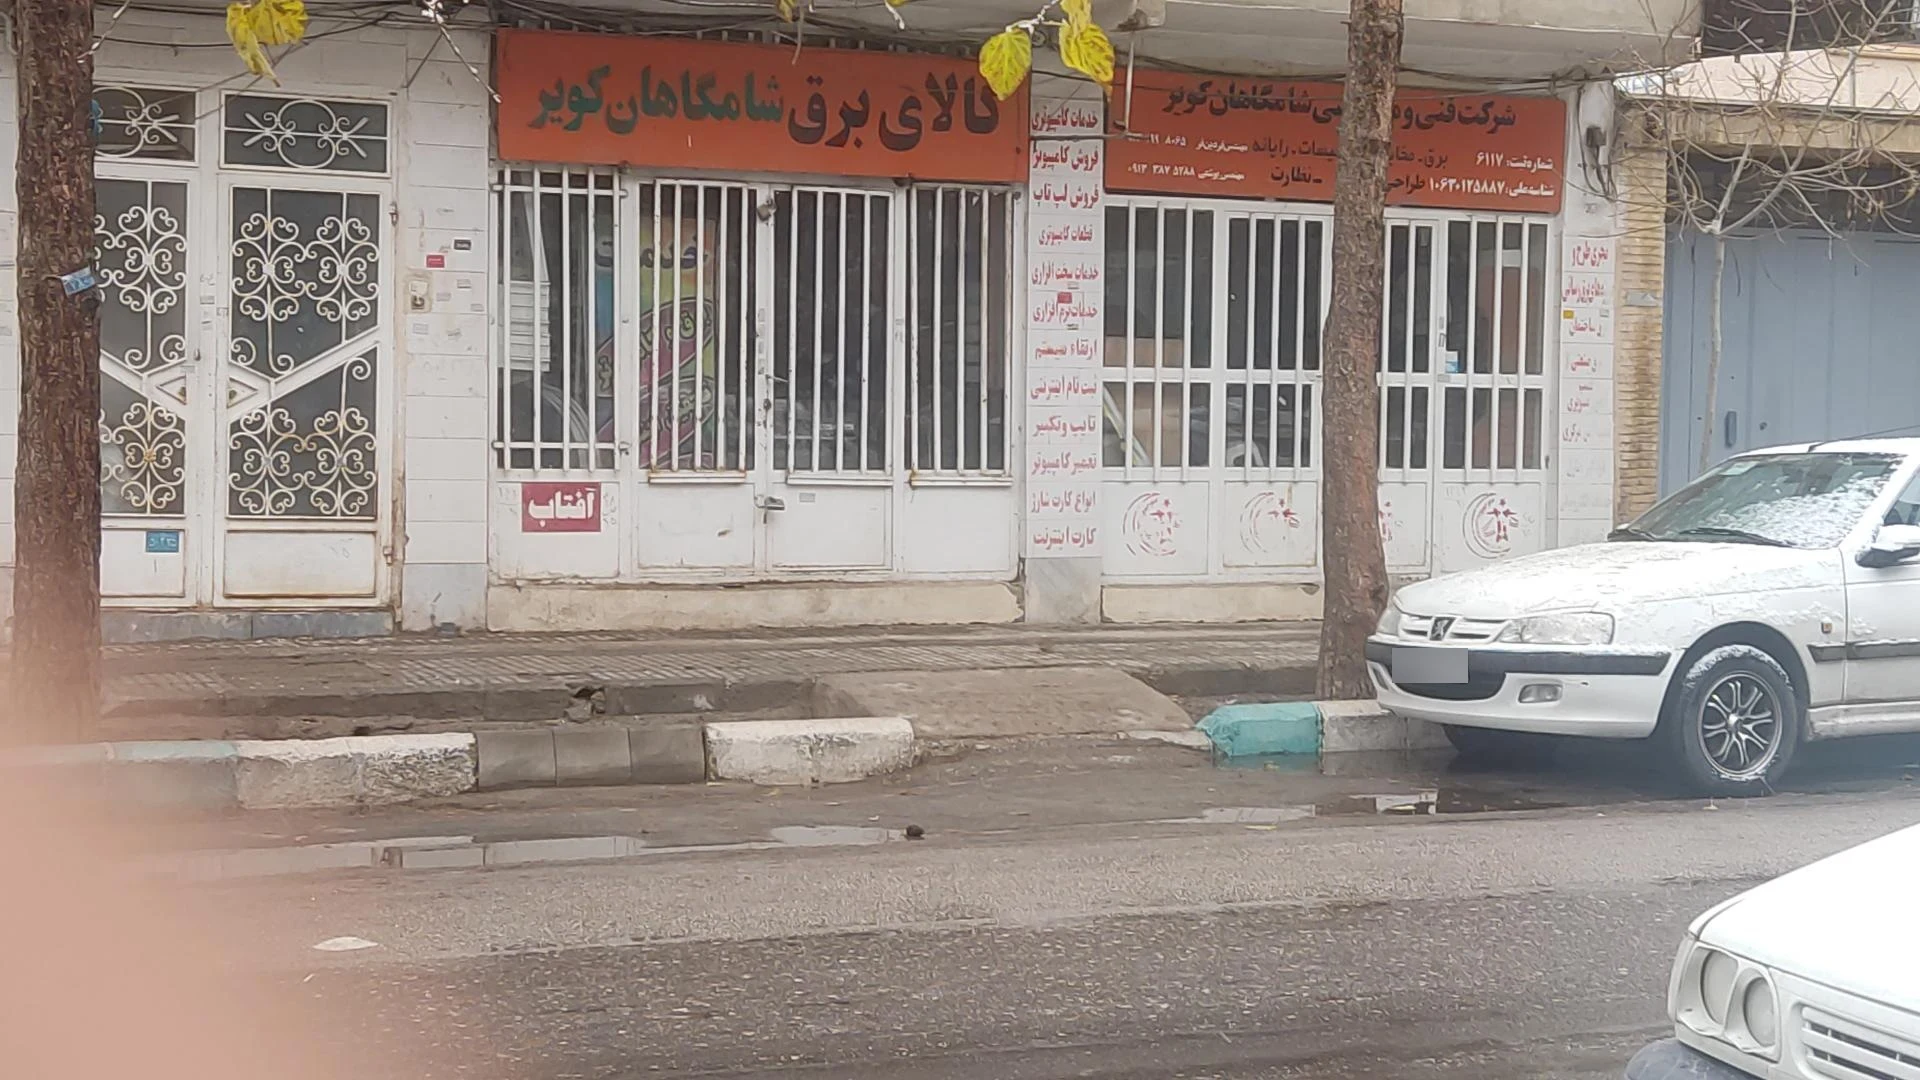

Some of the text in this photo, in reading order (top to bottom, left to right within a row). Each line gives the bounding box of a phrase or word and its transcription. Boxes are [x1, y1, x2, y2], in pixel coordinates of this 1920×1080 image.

[528, 65, 1000, 152] کالای برق شامگاهان کویر
[1162, 81, 1213, 116] کویر
[1209, 80, 1312, 116] شامگاهان
[1415, 98, 1456, 130] فنی
[1458, 100, 1516, 134] شرکت
[1071, 145, 1099, 171] فروش
[1069, 184, 1099, 209] فروش
[528, 487, 597, 528] آفتاب
